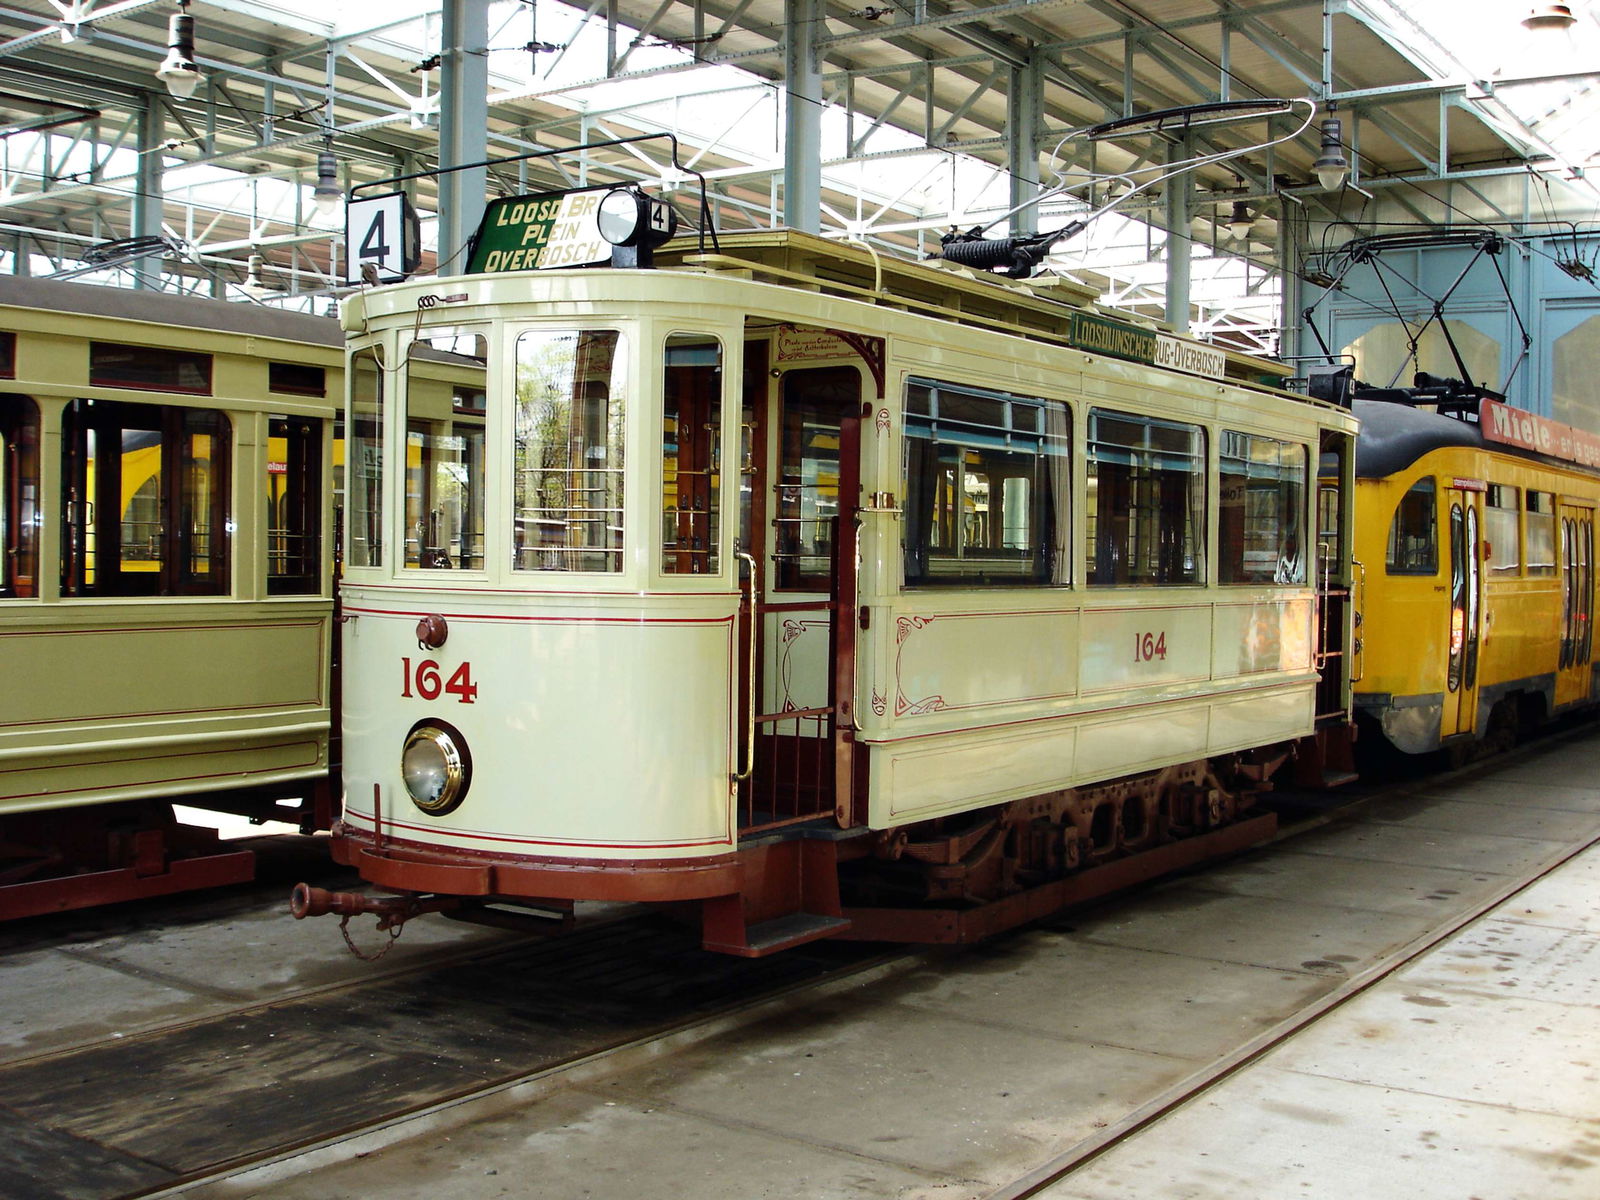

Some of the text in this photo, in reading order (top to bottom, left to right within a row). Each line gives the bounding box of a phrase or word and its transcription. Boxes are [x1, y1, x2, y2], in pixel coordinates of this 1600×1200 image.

[496, 195, 602, 227] LOOSD.BR
[653, 204, 664, 229] 4
[359, 210, 390, 270] 4
[521, 221, 581, 246] PLEIN
[484, 240, 602, 273] OVERBOSCH
[1134, 631, 1167, 663] 164
[401, 657, 477, 704] 164
